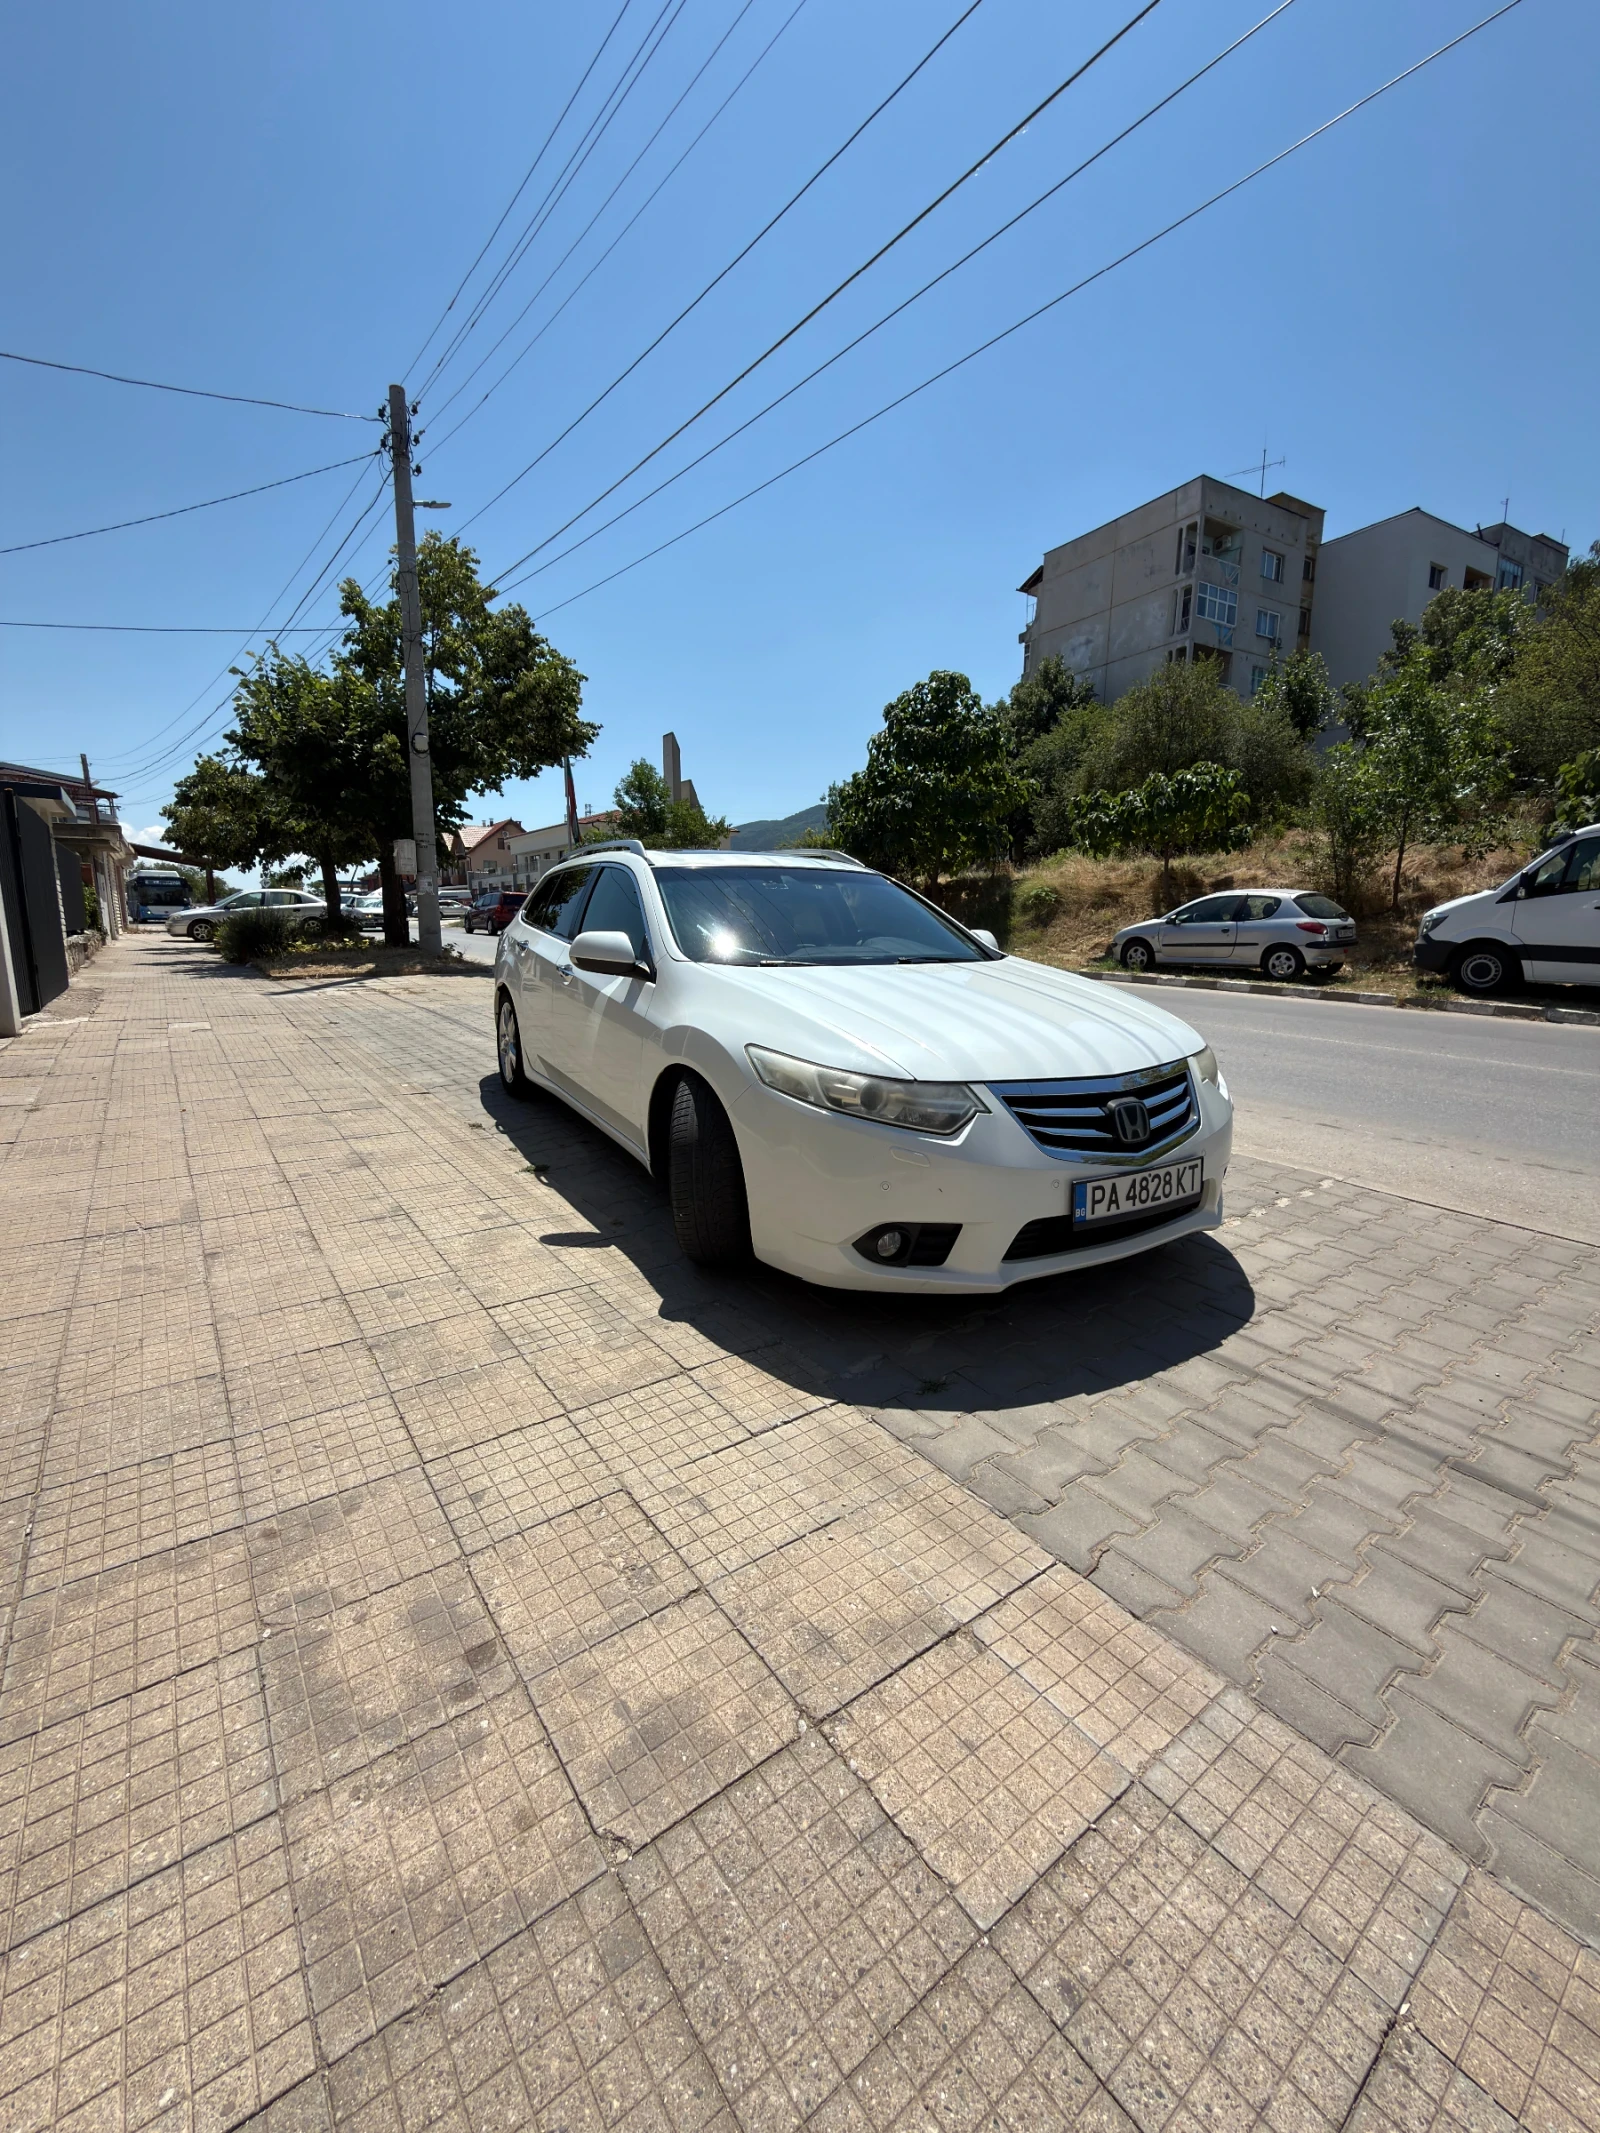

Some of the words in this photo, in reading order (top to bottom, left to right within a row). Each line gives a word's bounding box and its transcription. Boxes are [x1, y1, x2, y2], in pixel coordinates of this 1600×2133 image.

[1091, 1183, 1120, 1215] PA
[1126, 1171, 1172, 1206] 4828
[1176, 1164, 1199, 1195] KT
[1075, 1208, 1086, 1217] BG
